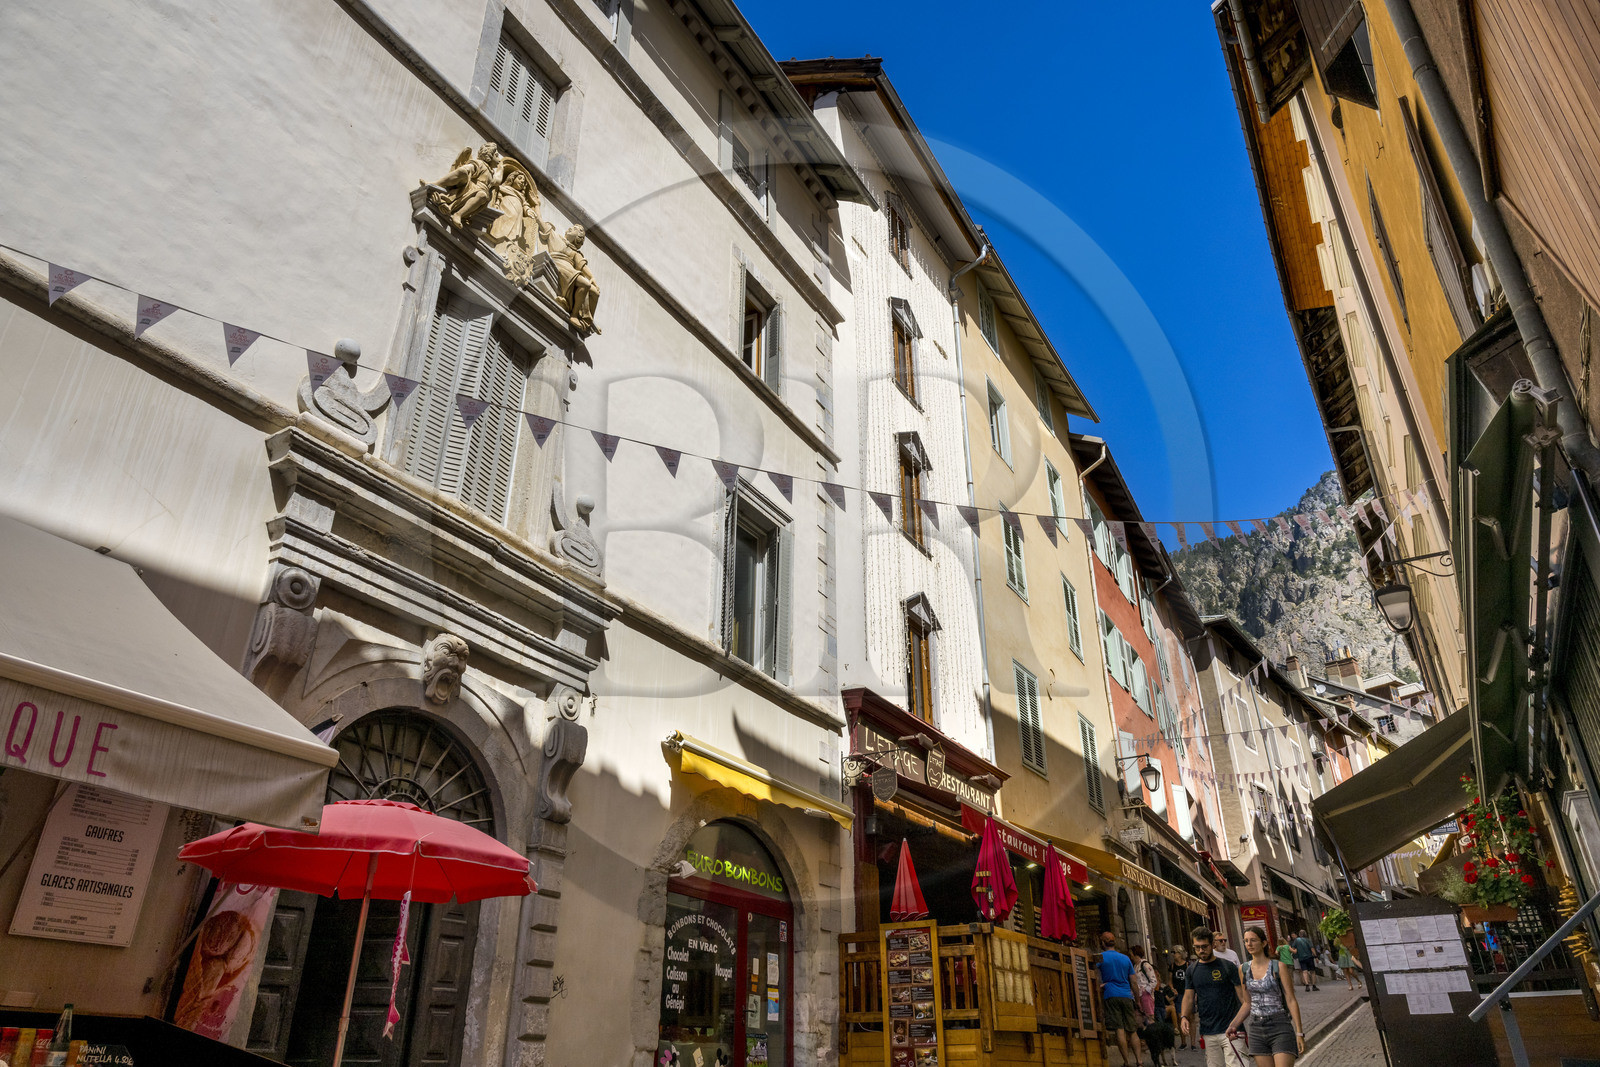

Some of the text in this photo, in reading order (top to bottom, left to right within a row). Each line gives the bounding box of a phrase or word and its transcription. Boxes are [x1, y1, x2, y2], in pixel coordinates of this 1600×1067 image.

[5, 701, 118, 778] QUE
[941, 771, 991, 811] RESTAURANT
[85, 824, 125, 843] GAUFRES
[41, 873, 135, 899] GLACES ARTISANALES
[667, 914, 737, 956] BONBONS ET CHOCOLATS
[667, 945, 690, 962] Chocolat
[688, 938, 718, 954] EN VRAC
[666, 965, 688, 982] Calisson
[715, 963, 733, 982] Nougat
[665, 994, 685, 1014] Génépi
[77, 1054, 112, 1065] NUTELLA
